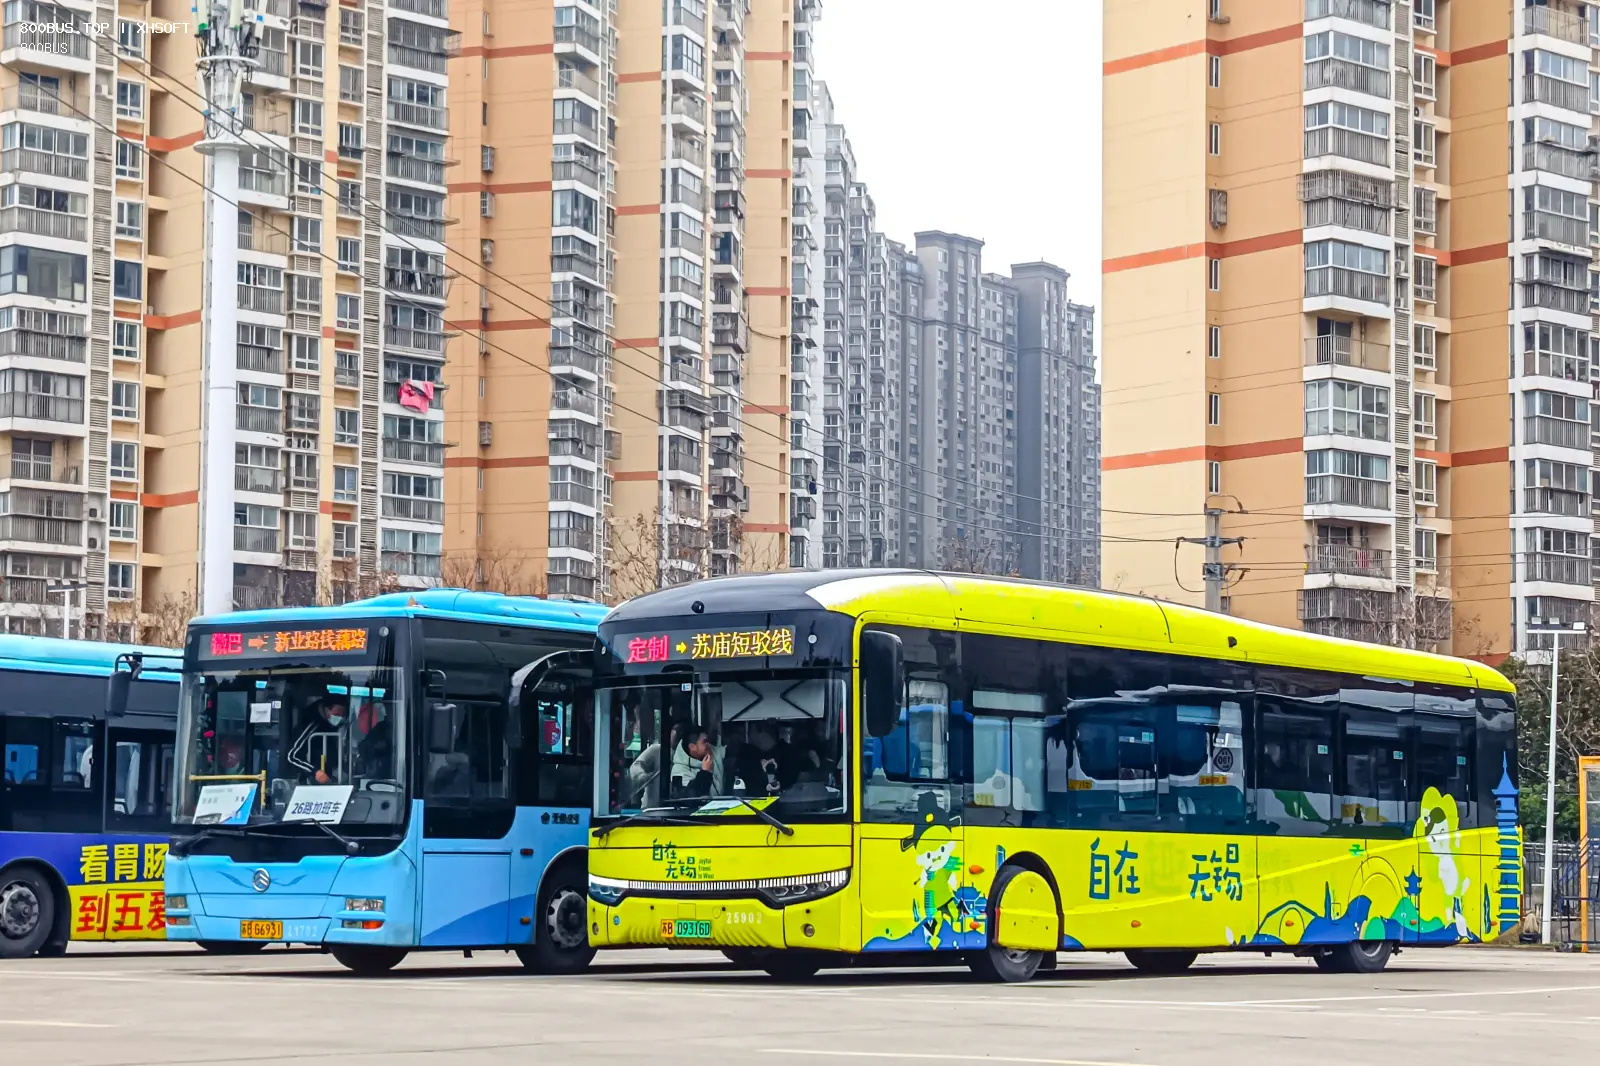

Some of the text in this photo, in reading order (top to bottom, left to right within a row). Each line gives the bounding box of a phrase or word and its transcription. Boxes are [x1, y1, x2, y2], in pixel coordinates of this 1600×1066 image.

[627, 627, 793, 664] 定制 苏庙短驳线
[291, 800, 342, 815] 26路加班车
[80, 843, 170, 883] 看胃肠
[652, 837, 678, 861] 自在
[665, 856, 697, 879] 无锡
[1089, 836, 1141, 900] 自在
[1188, 843, 1243, 901] 无锡
